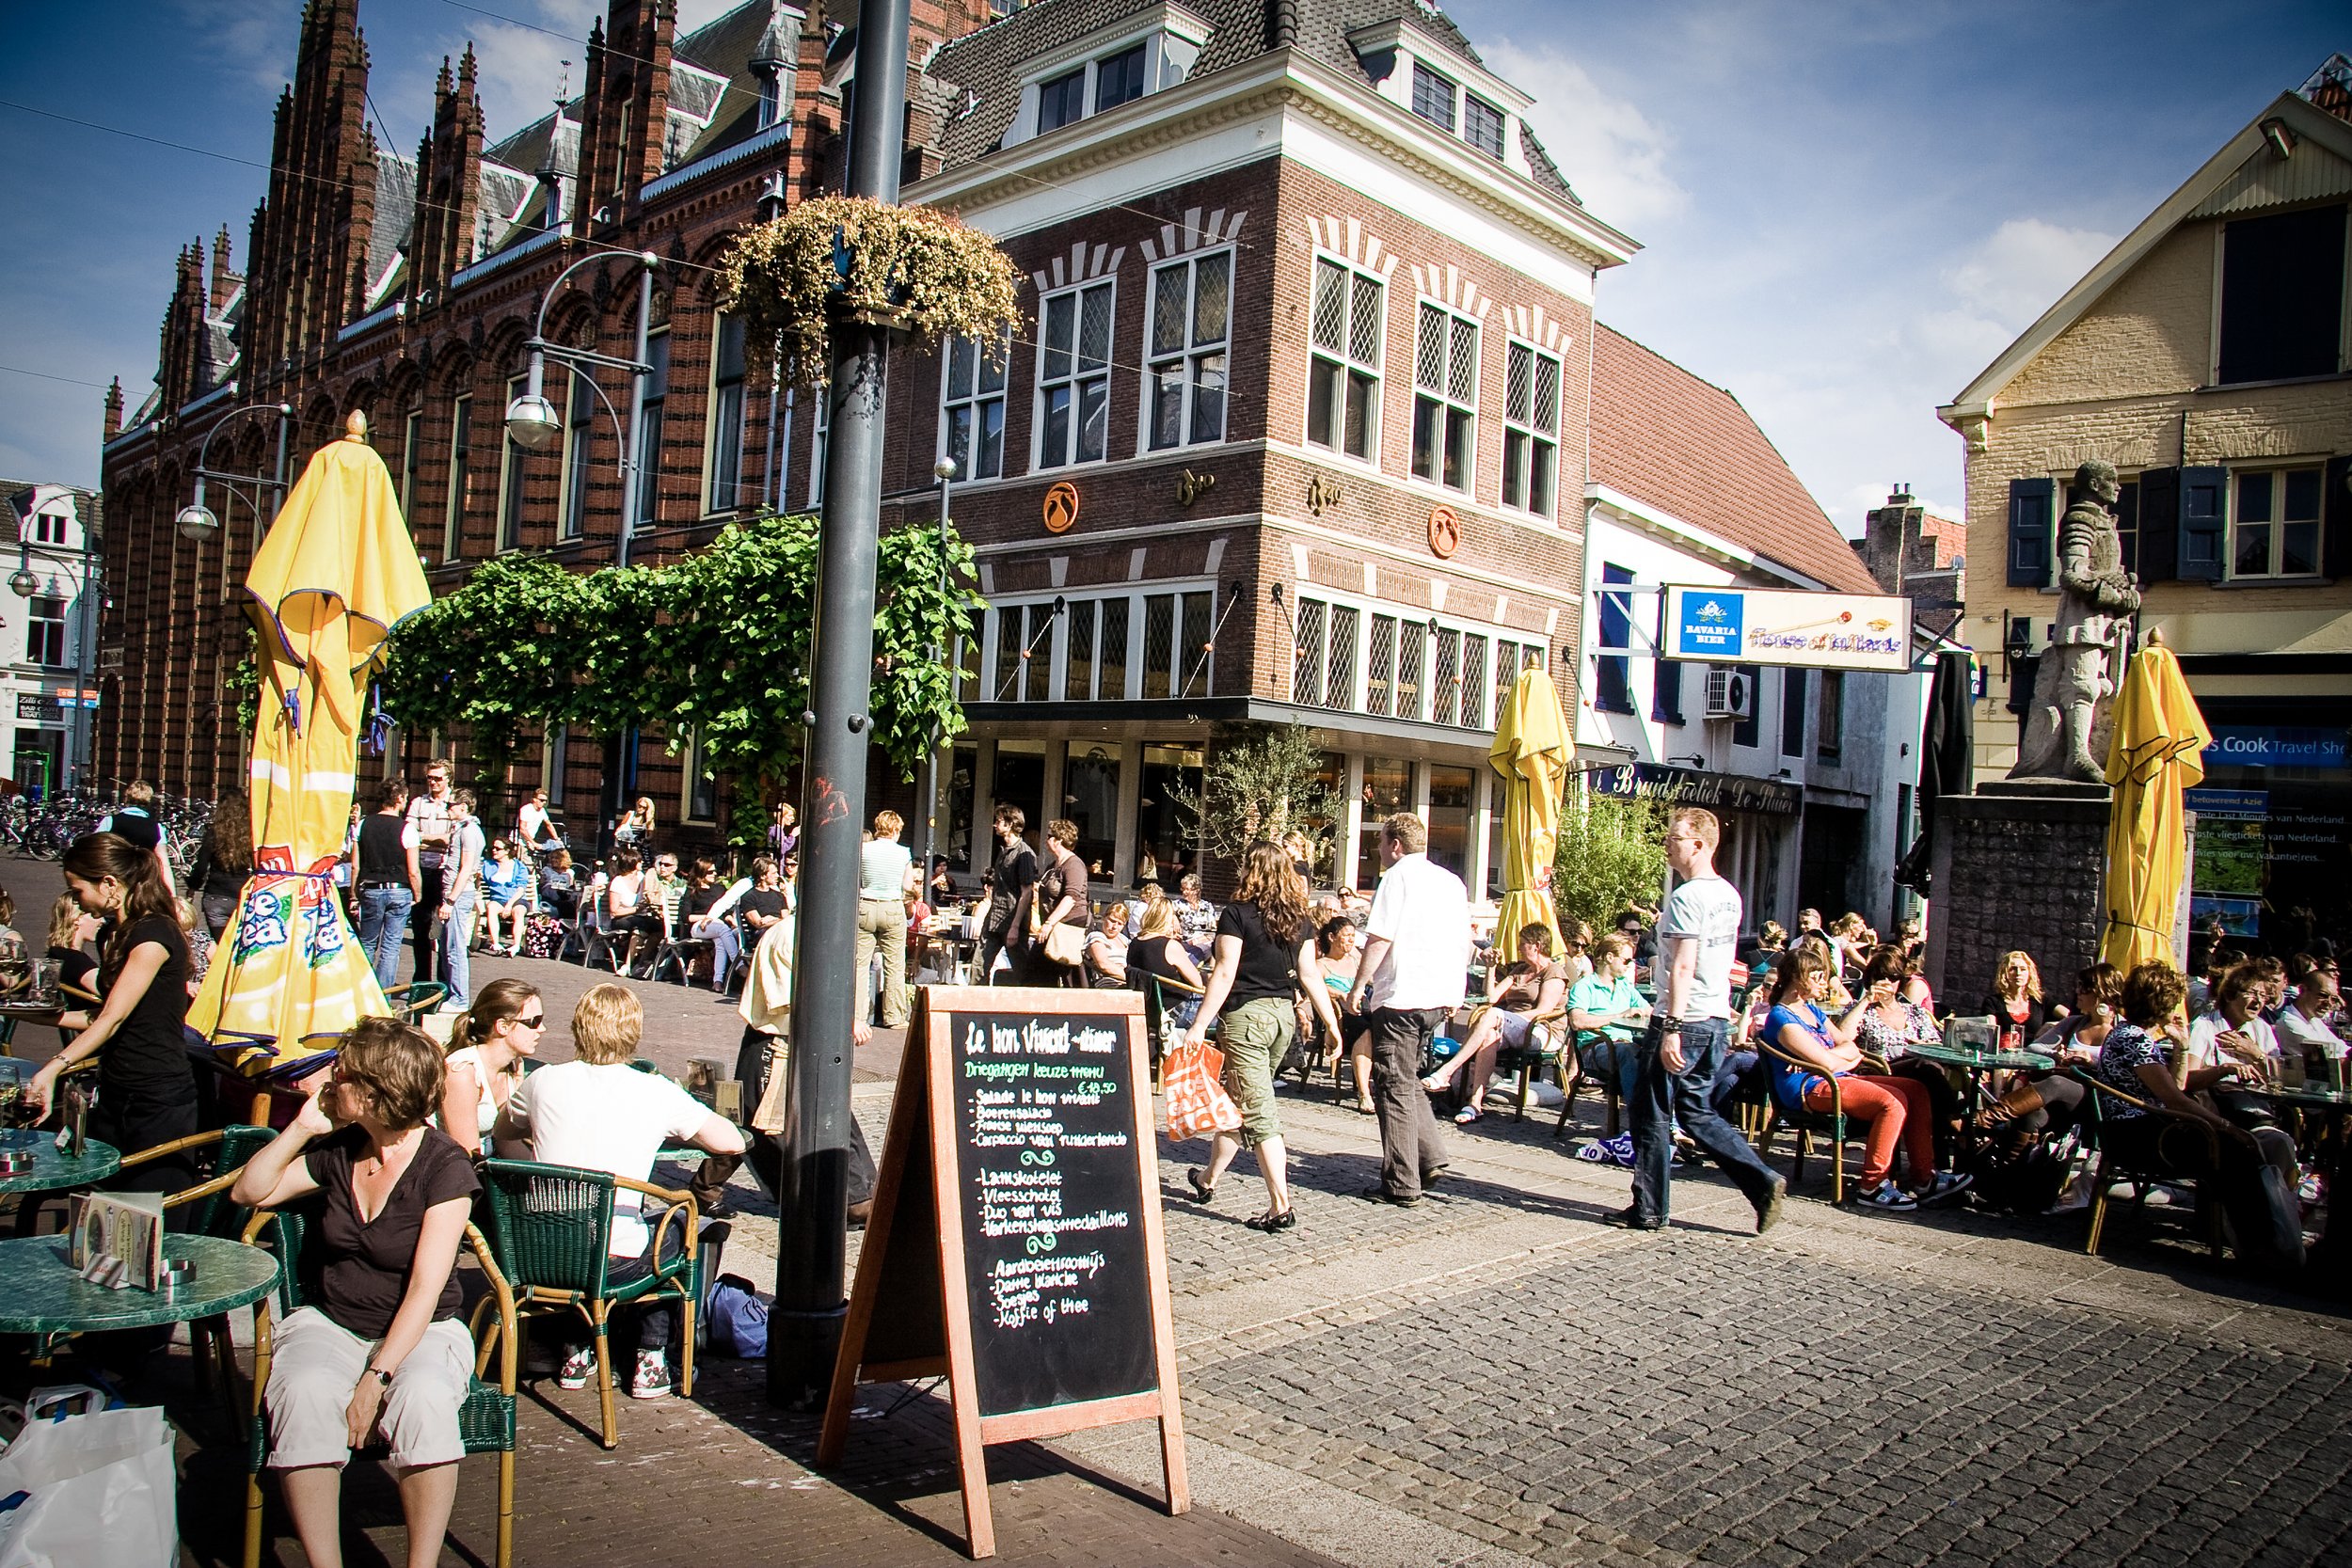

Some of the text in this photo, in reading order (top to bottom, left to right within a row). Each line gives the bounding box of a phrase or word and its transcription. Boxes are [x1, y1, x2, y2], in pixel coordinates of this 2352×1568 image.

[1685, 625, 1737, 637] BAVARIA
[1695, 635, 1726, 645] BIER
[2223, 736, 2268, 753] Cook
[2273, 740, 2317, 754] Travel
[2322, 740, 2345, 755] Sho
[1732, 780, 1751, 808] De
[2218, 812, 2236, 821] Last
[2239, 813, 2274, 822] Minutes
[2217, 831, 2265, 842] vliegtickets
[2268, 833, 2284, 842] van
[2217, 849, 2238, 859] voor
[2240, 850, 2255, 859] uw
[965, 1022, 986, 1055] Le
[992, 1022, 1021, 1053] bon
[964, 1061, 1104, 1083] Driegangen keuze menu
[1021, 1088, 1032, 1104] le
[1035, 1088, 1057, 1105] bon
[1059, 1089, 1101, 1105] vivant
[1015, 1121, 1064, 1136] uiensoep
[1029, 1134, 1055, 1148] van
[1058, 1131, 1128, 1147] runderlende
[1010, 1204, 1035, 1219] van
[1041, 1203, 1062, 1217] vis
[1035, 1270, 1079, 1289] blanche
[1042, 1299, 1057, 1324] of
[1060, 1298, 1089, 1314] thee
